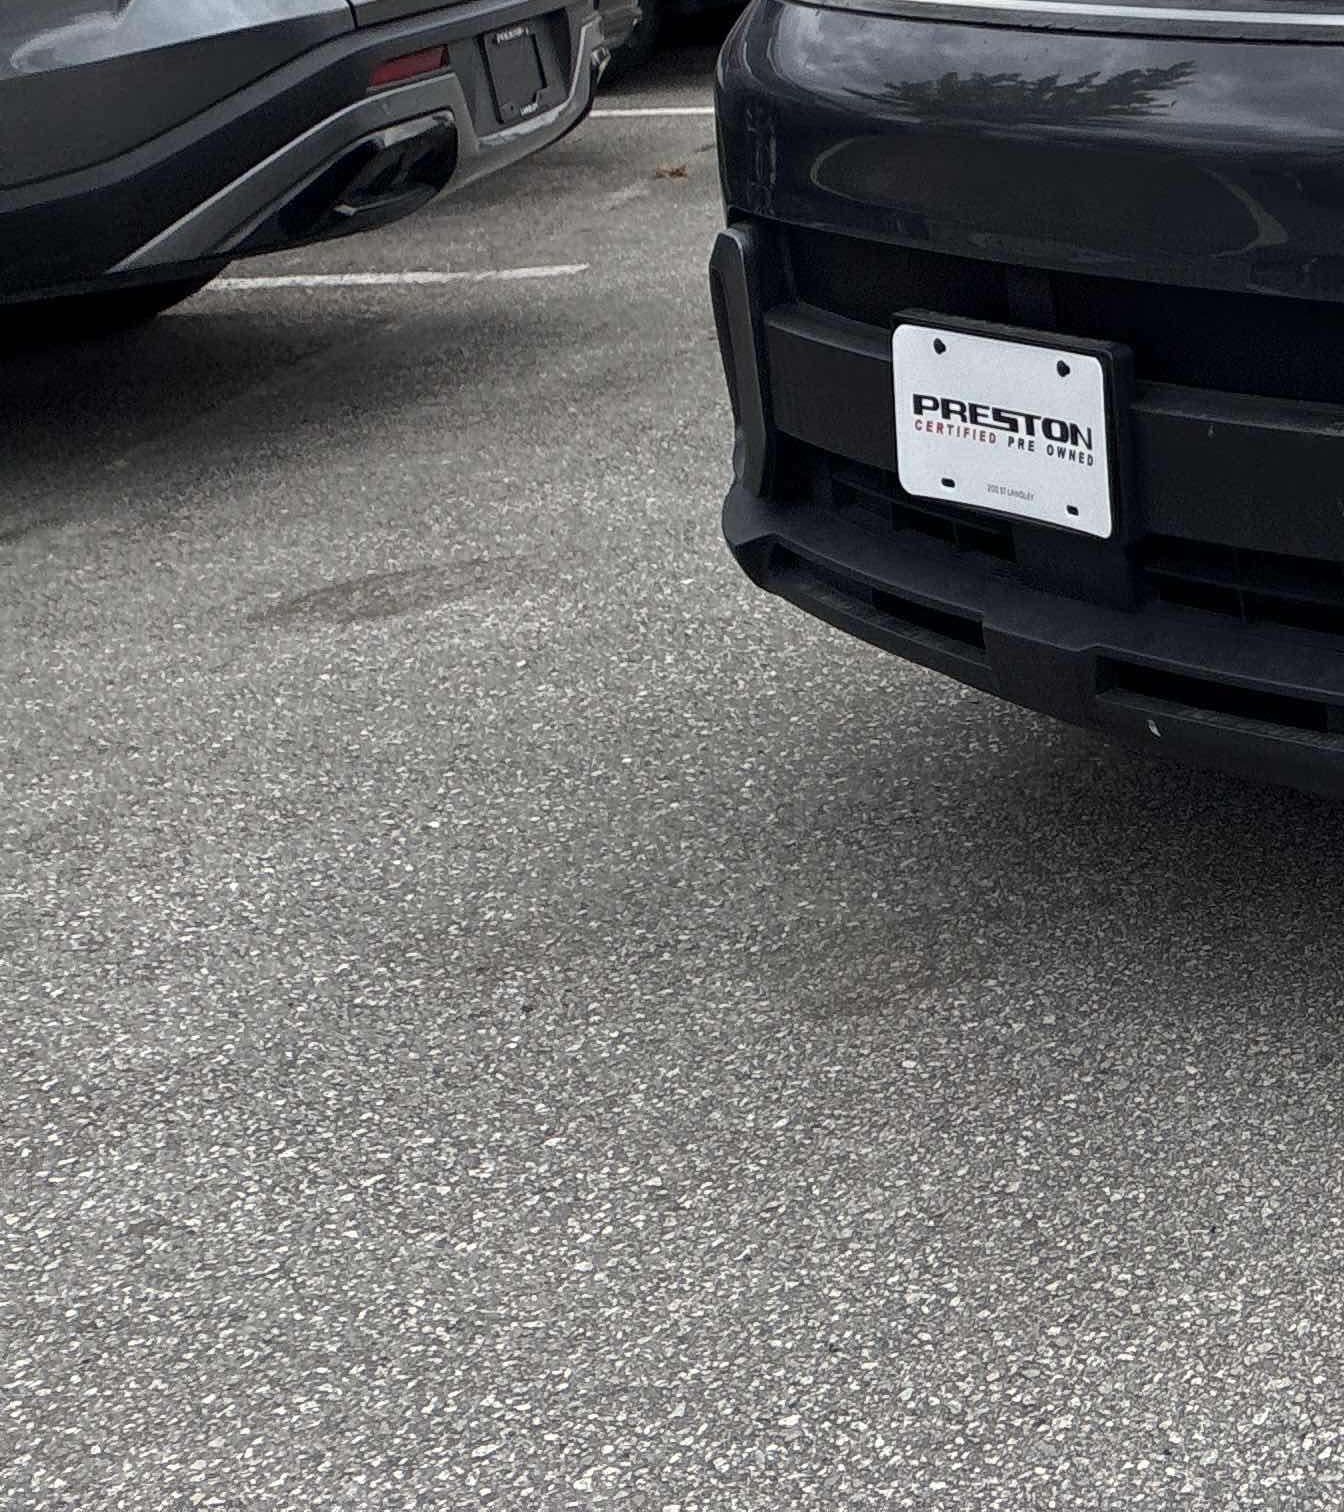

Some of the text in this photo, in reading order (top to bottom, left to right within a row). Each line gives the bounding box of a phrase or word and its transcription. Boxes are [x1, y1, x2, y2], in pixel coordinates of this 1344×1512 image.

[912, 393, 1093, 451] PRESTON
[914, 419, 1095, 467] CERTIFIED PRE OWNED
